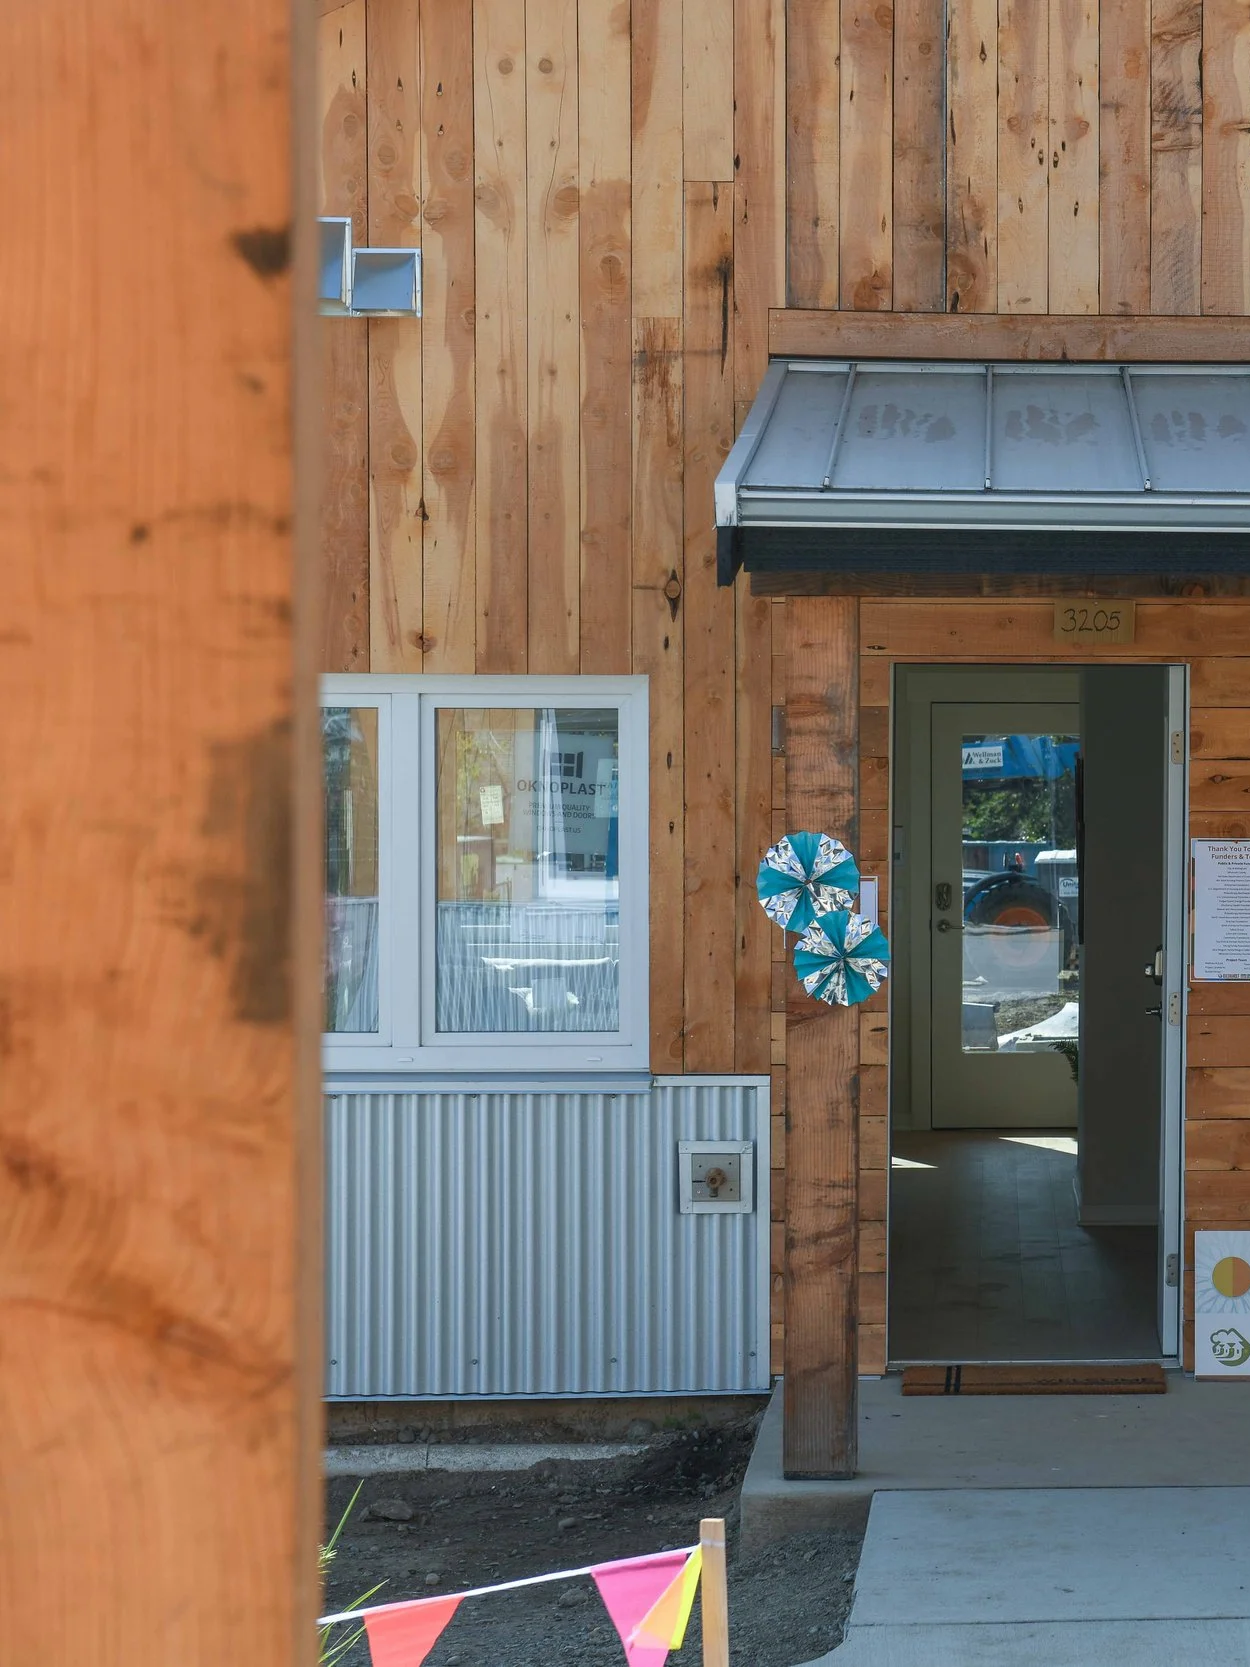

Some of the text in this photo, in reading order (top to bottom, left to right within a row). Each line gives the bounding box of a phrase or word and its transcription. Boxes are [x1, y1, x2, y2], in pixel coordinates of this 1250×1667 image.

[1061, 608, 1121, 633] 3205
[528, 801, 591, 812] PREUM QUALITY
[523, 809, 556, 817] WINDS
